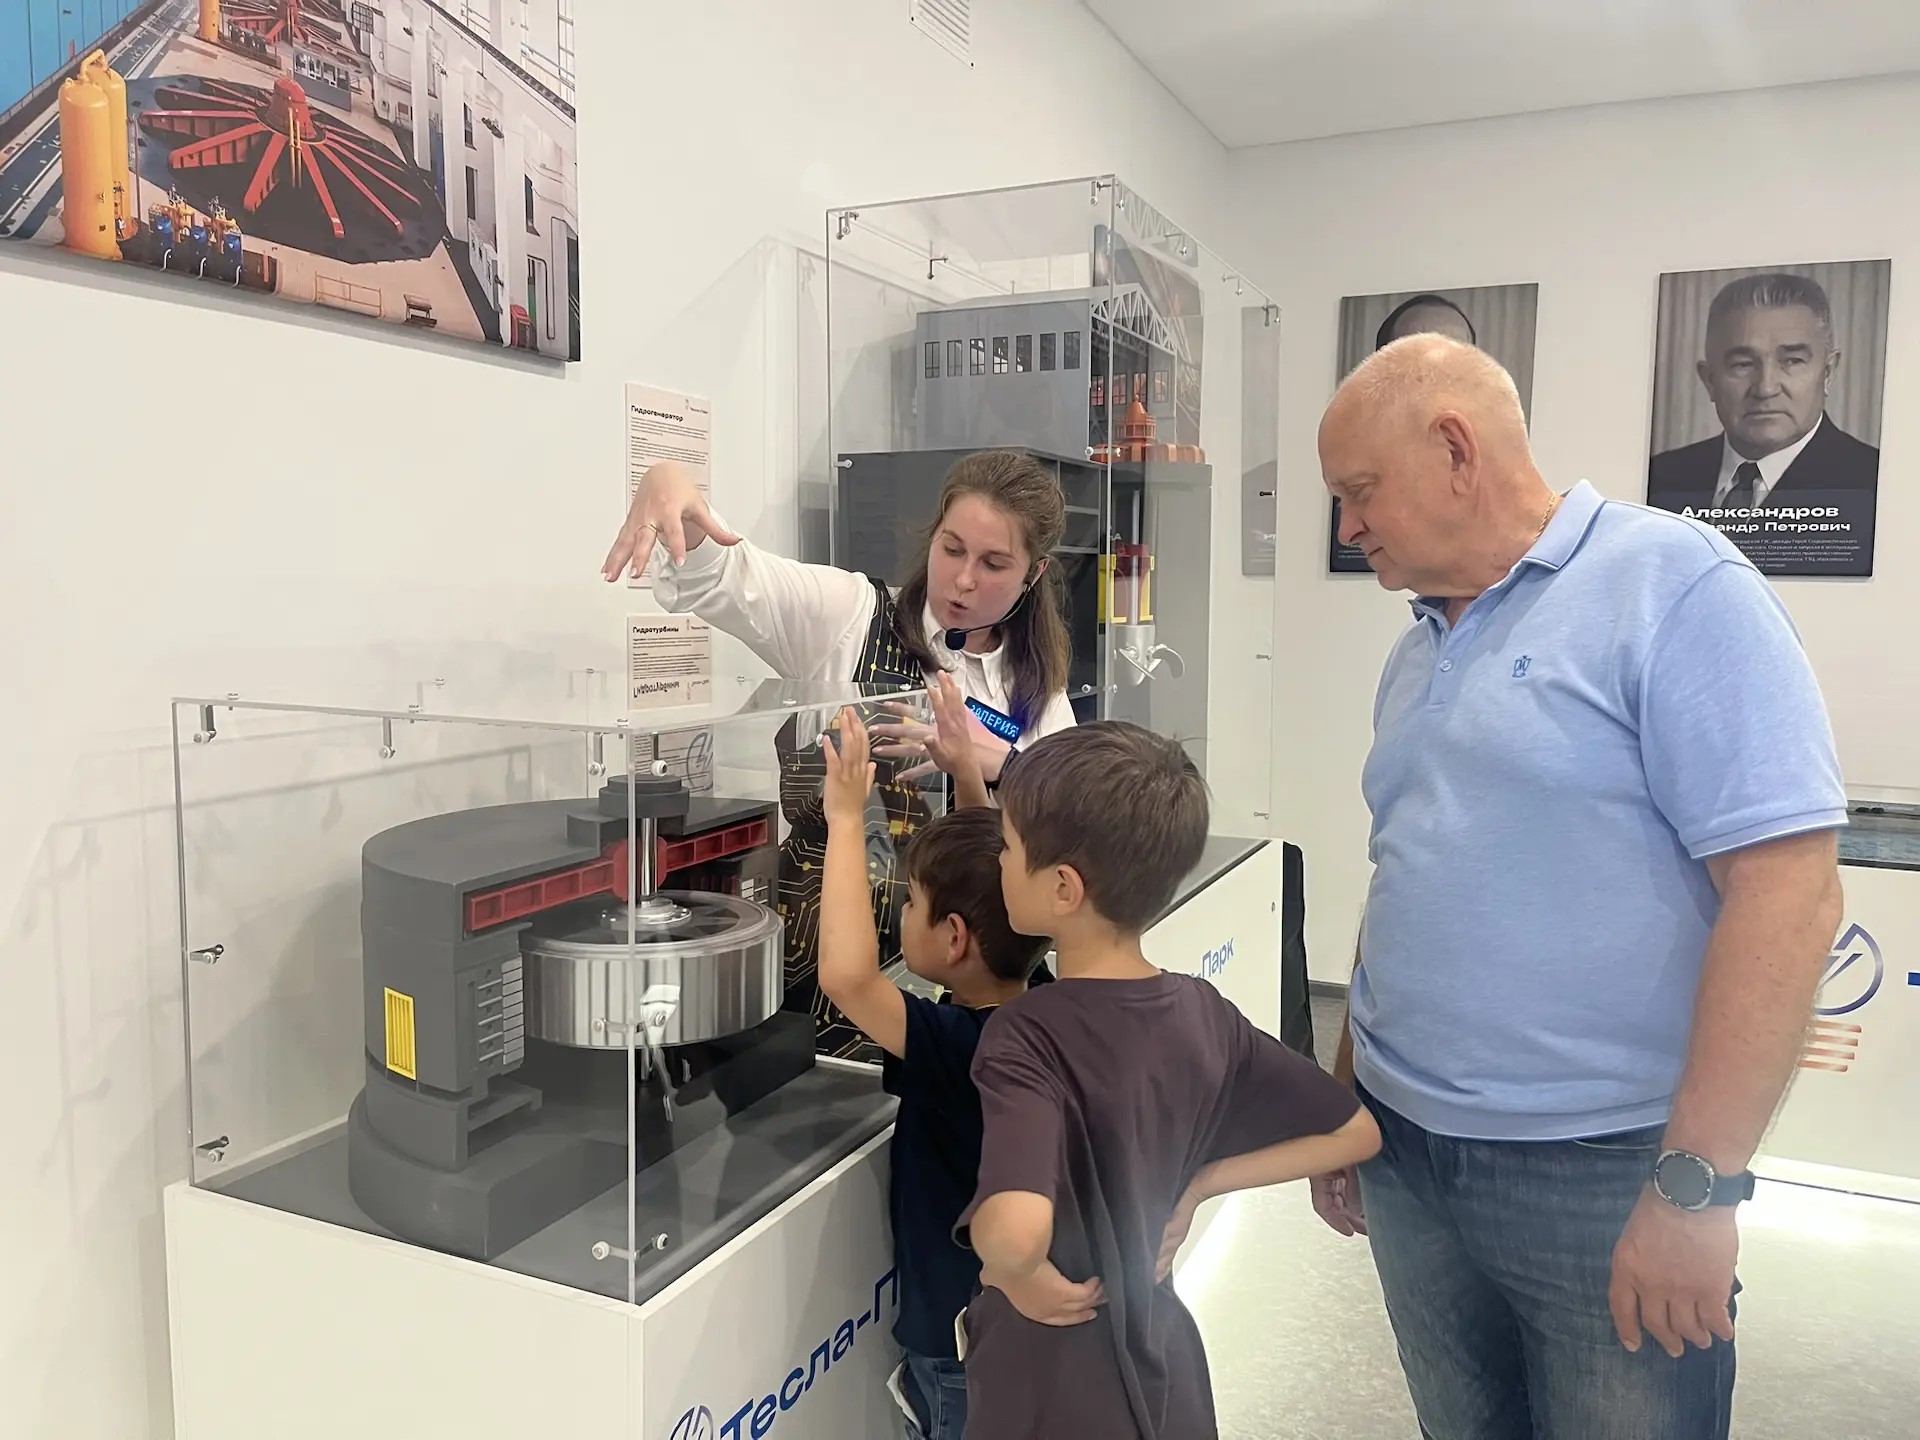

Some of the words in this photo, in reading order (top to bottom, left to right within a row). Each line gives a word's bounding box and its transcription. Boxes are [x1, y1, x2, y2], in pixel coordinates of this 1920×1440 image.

[631, 405, 683, 422] Гидрогенератор
[1680, 505, 1839, 520] Александров
[1764, 521, 1851, 533] Петрович
[633, 626, 679, 634] Гидротурбины
[1191, 937, 1234, 979] -Парк
[720, 1265, 897, 1440] Тесла-П
